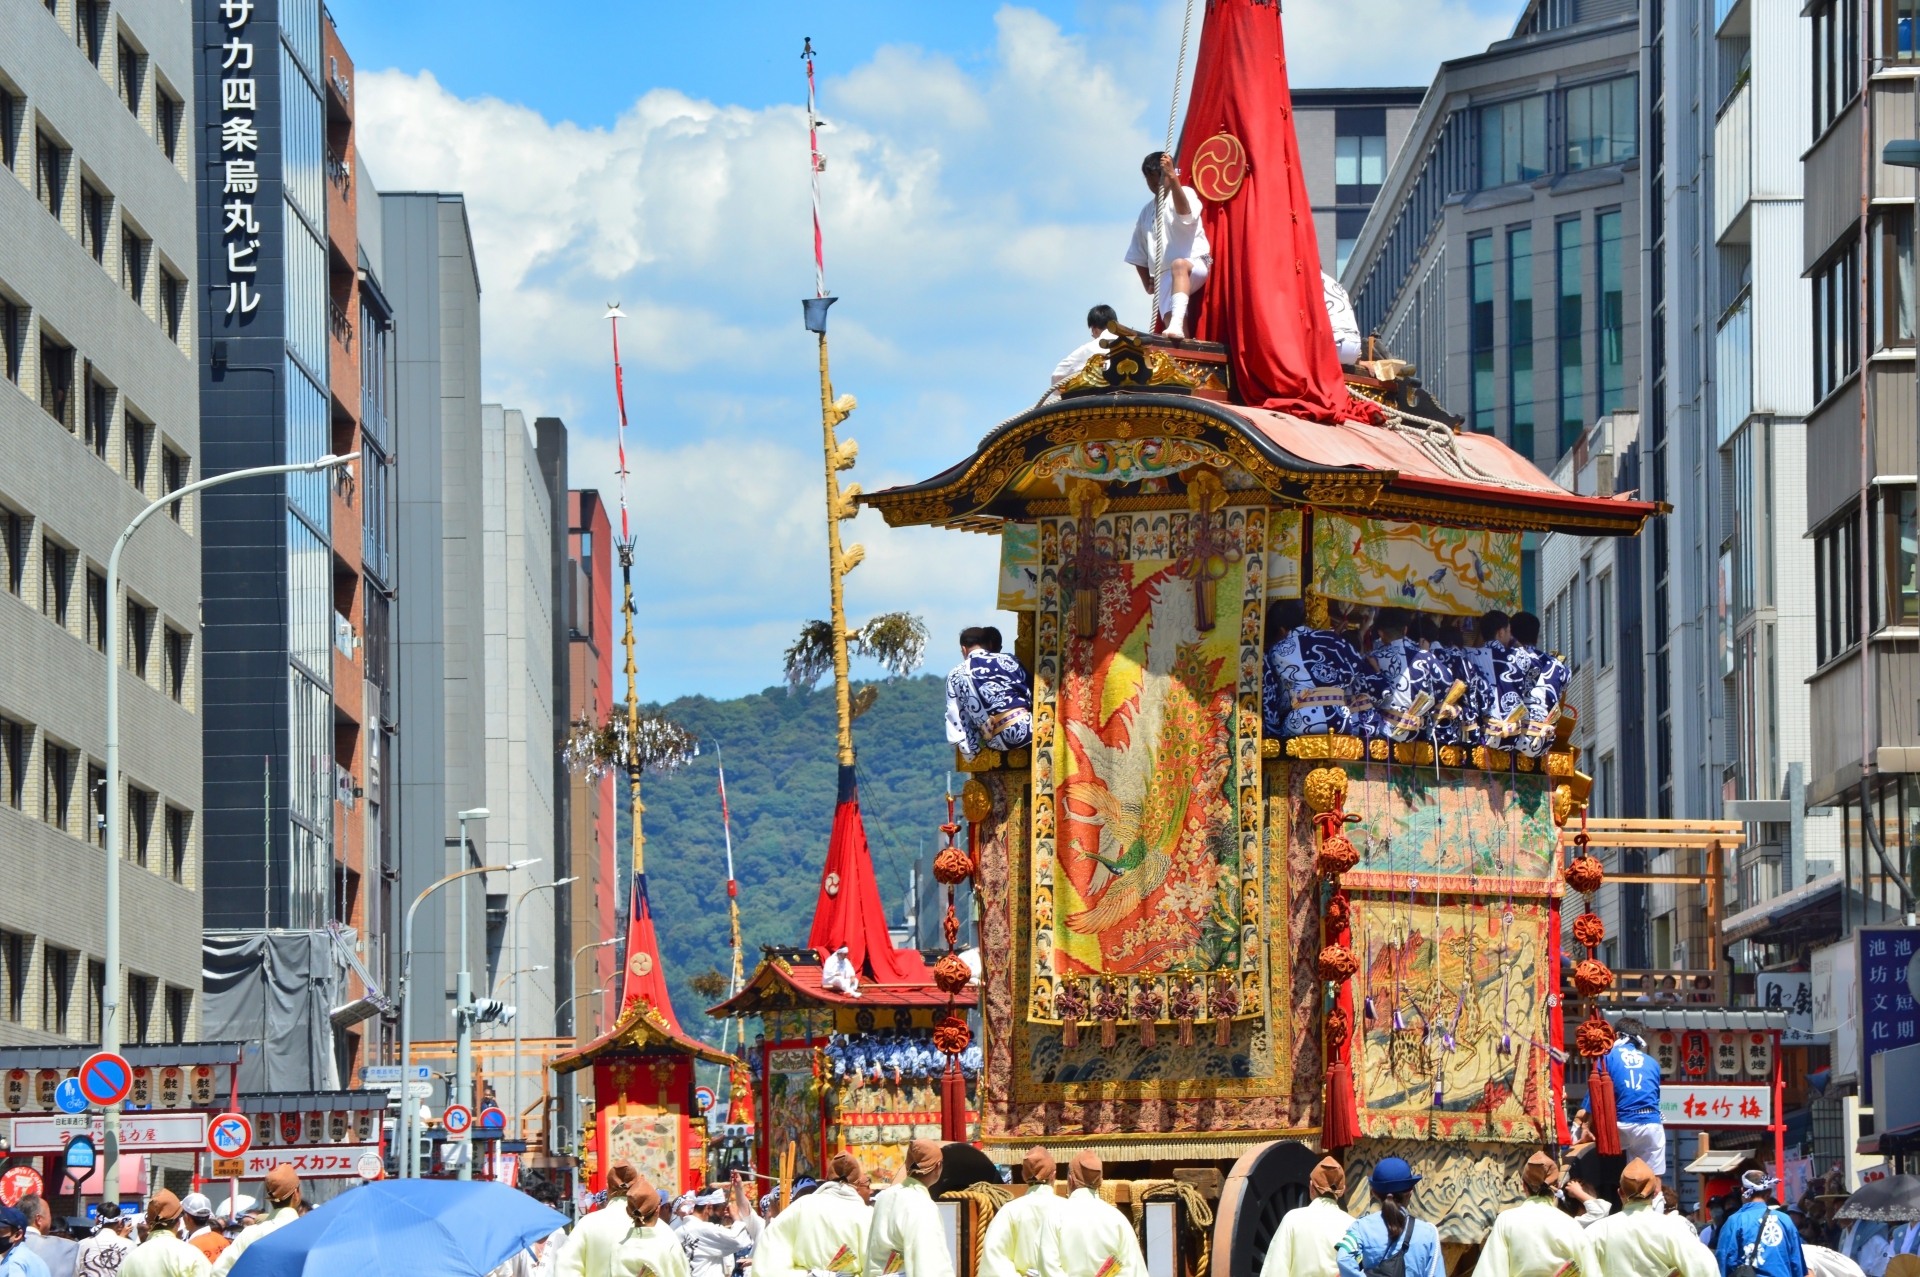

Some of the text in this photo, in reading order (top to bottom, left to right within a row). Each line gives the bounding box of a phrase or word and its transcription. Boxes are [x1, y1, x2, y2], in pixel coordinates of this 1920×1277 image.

[220, 0, 260, 314] サカ四条烏丸ビル
[1869, 938, 1889, 1055] 池坊文化
[1687, 1036, 1707, 1073] 月鉾
[1683, 1093, 1763, 1119] 松竹梅
[69, 1154, 90, 1164] 市バス
[250, 1154, 352, 1172] ホリーズカフェ
